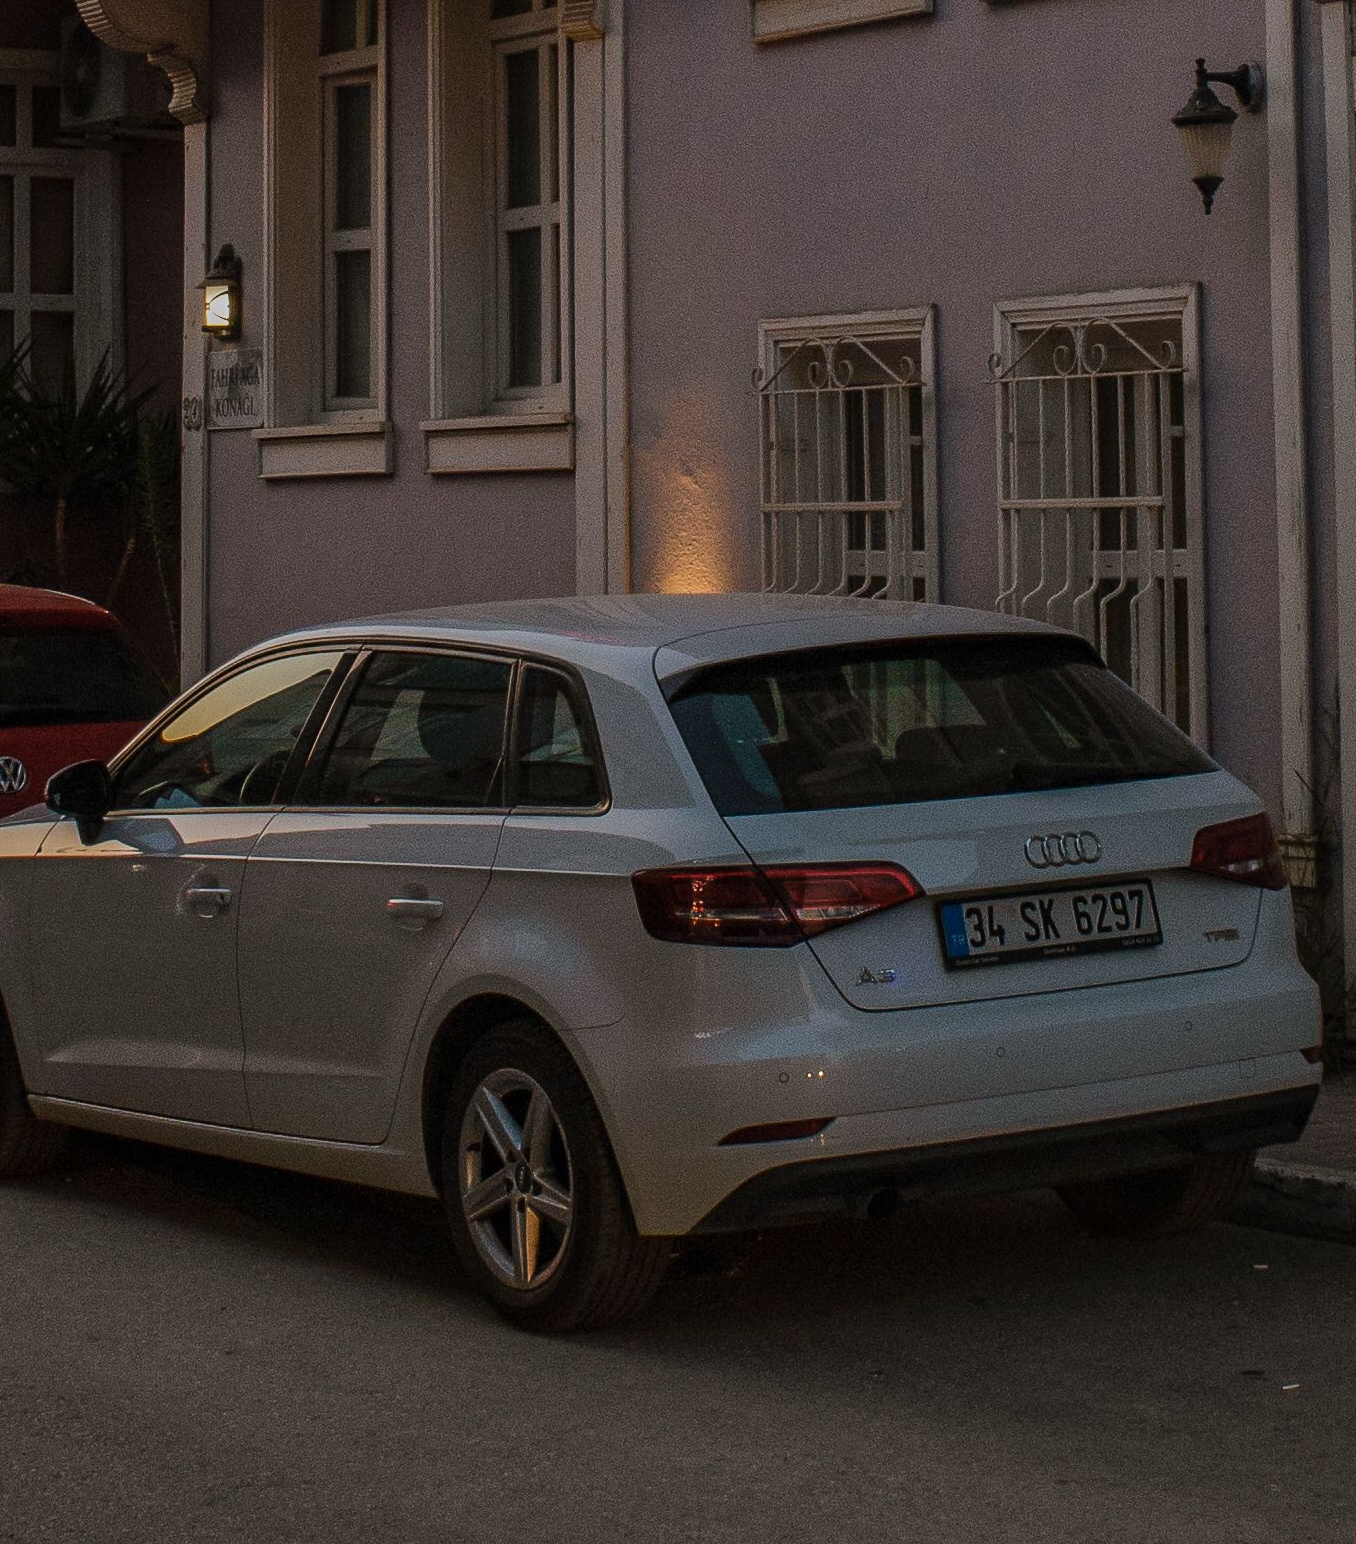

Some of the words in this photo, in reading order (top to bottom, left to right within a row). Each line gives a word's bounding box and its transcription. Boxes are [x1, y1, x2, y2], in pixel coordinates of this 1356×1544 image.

[964, 905, 1006, 948] 34
[1019, 898, 1061, 942] SK
[1071, 888, 1144, 936] 6297
[948, 934, 967, 946] TR
[855, 965, 897, 987] A3
